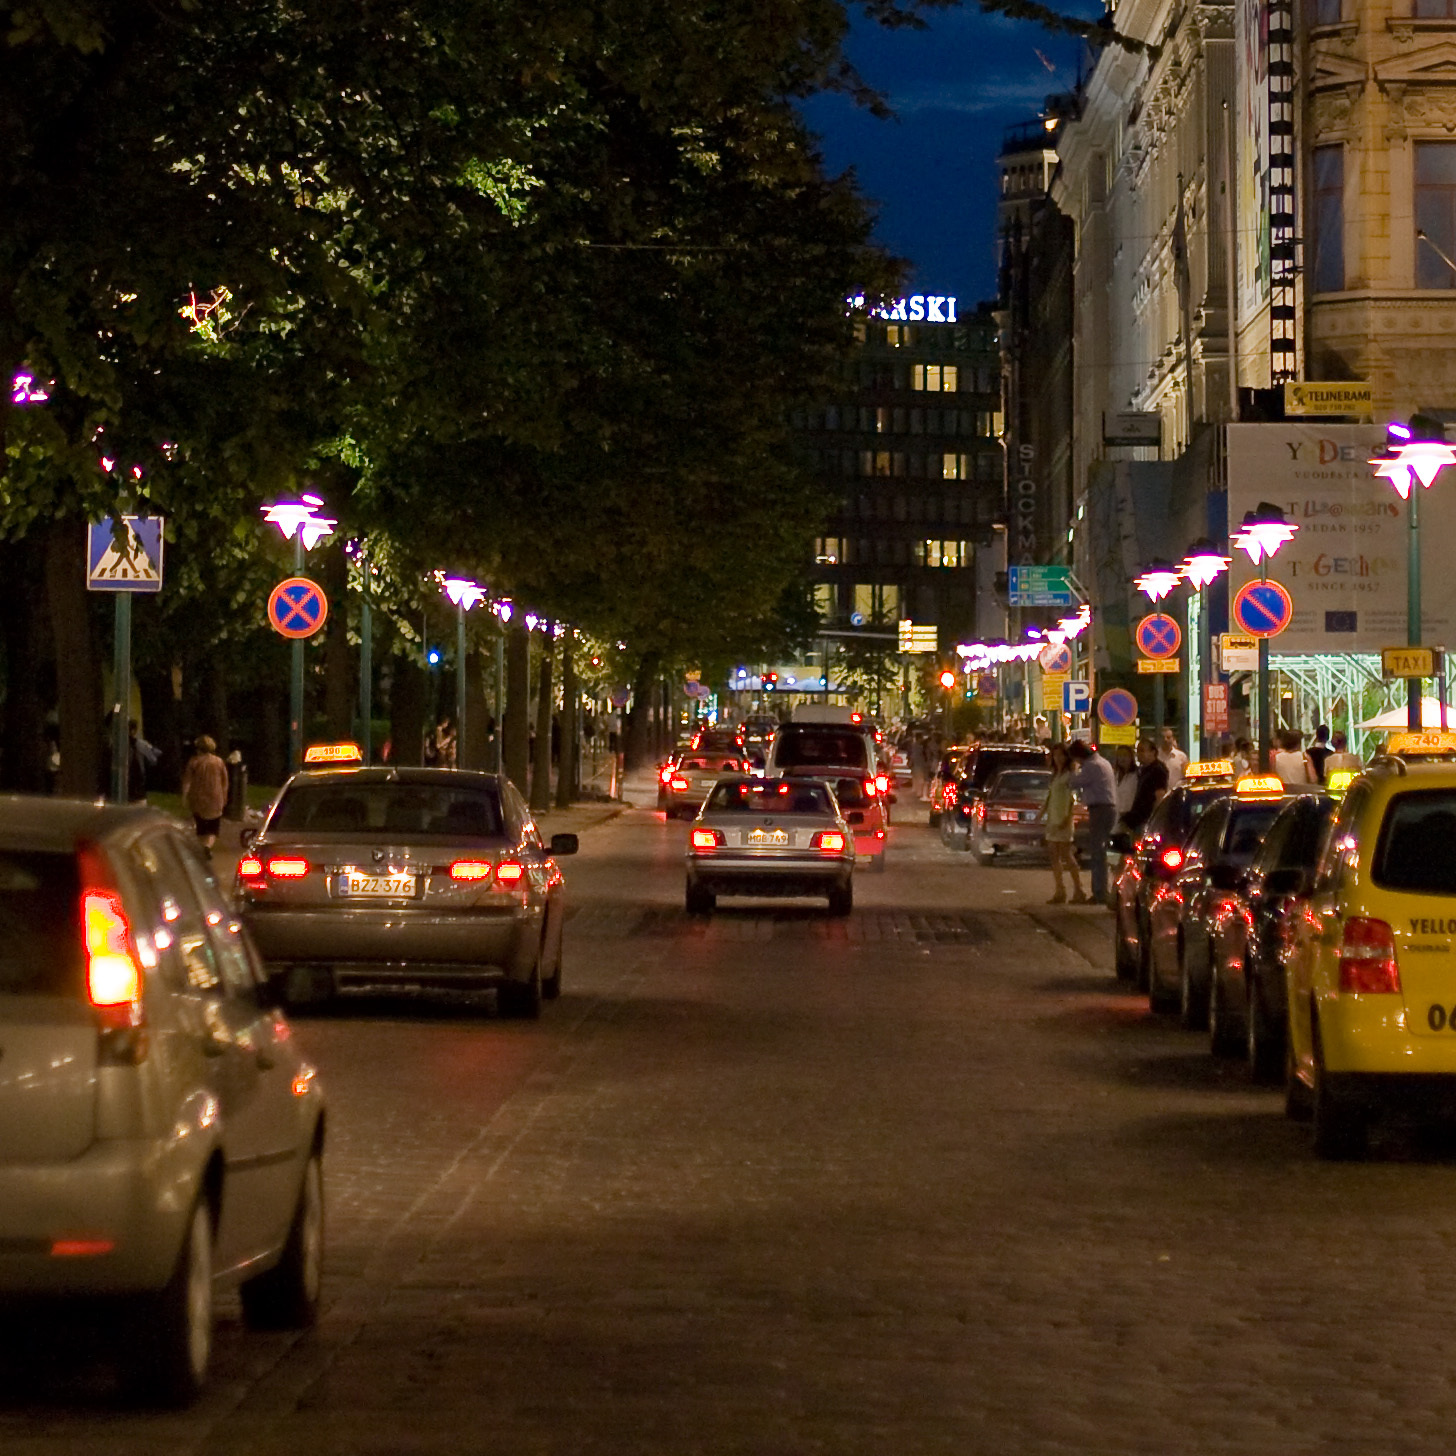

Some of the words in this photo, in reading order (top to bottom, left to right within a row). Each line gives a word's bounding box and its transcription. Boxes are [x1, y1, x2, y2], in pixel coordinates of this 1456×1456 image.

[846, 293, 957, 323] RSKI
[1018, 444, 1037, 566] STOCKMA
[1308, 582, 1347, 591] SINCE
[1393, 655, 1427, 671] TAXI
[1068, 683, 1089, 711] P
[1208, 685, 1225, 698] BUS
[1206, 700, 1227, 713] STOP
[1413, 735, 1440, 745] 740
